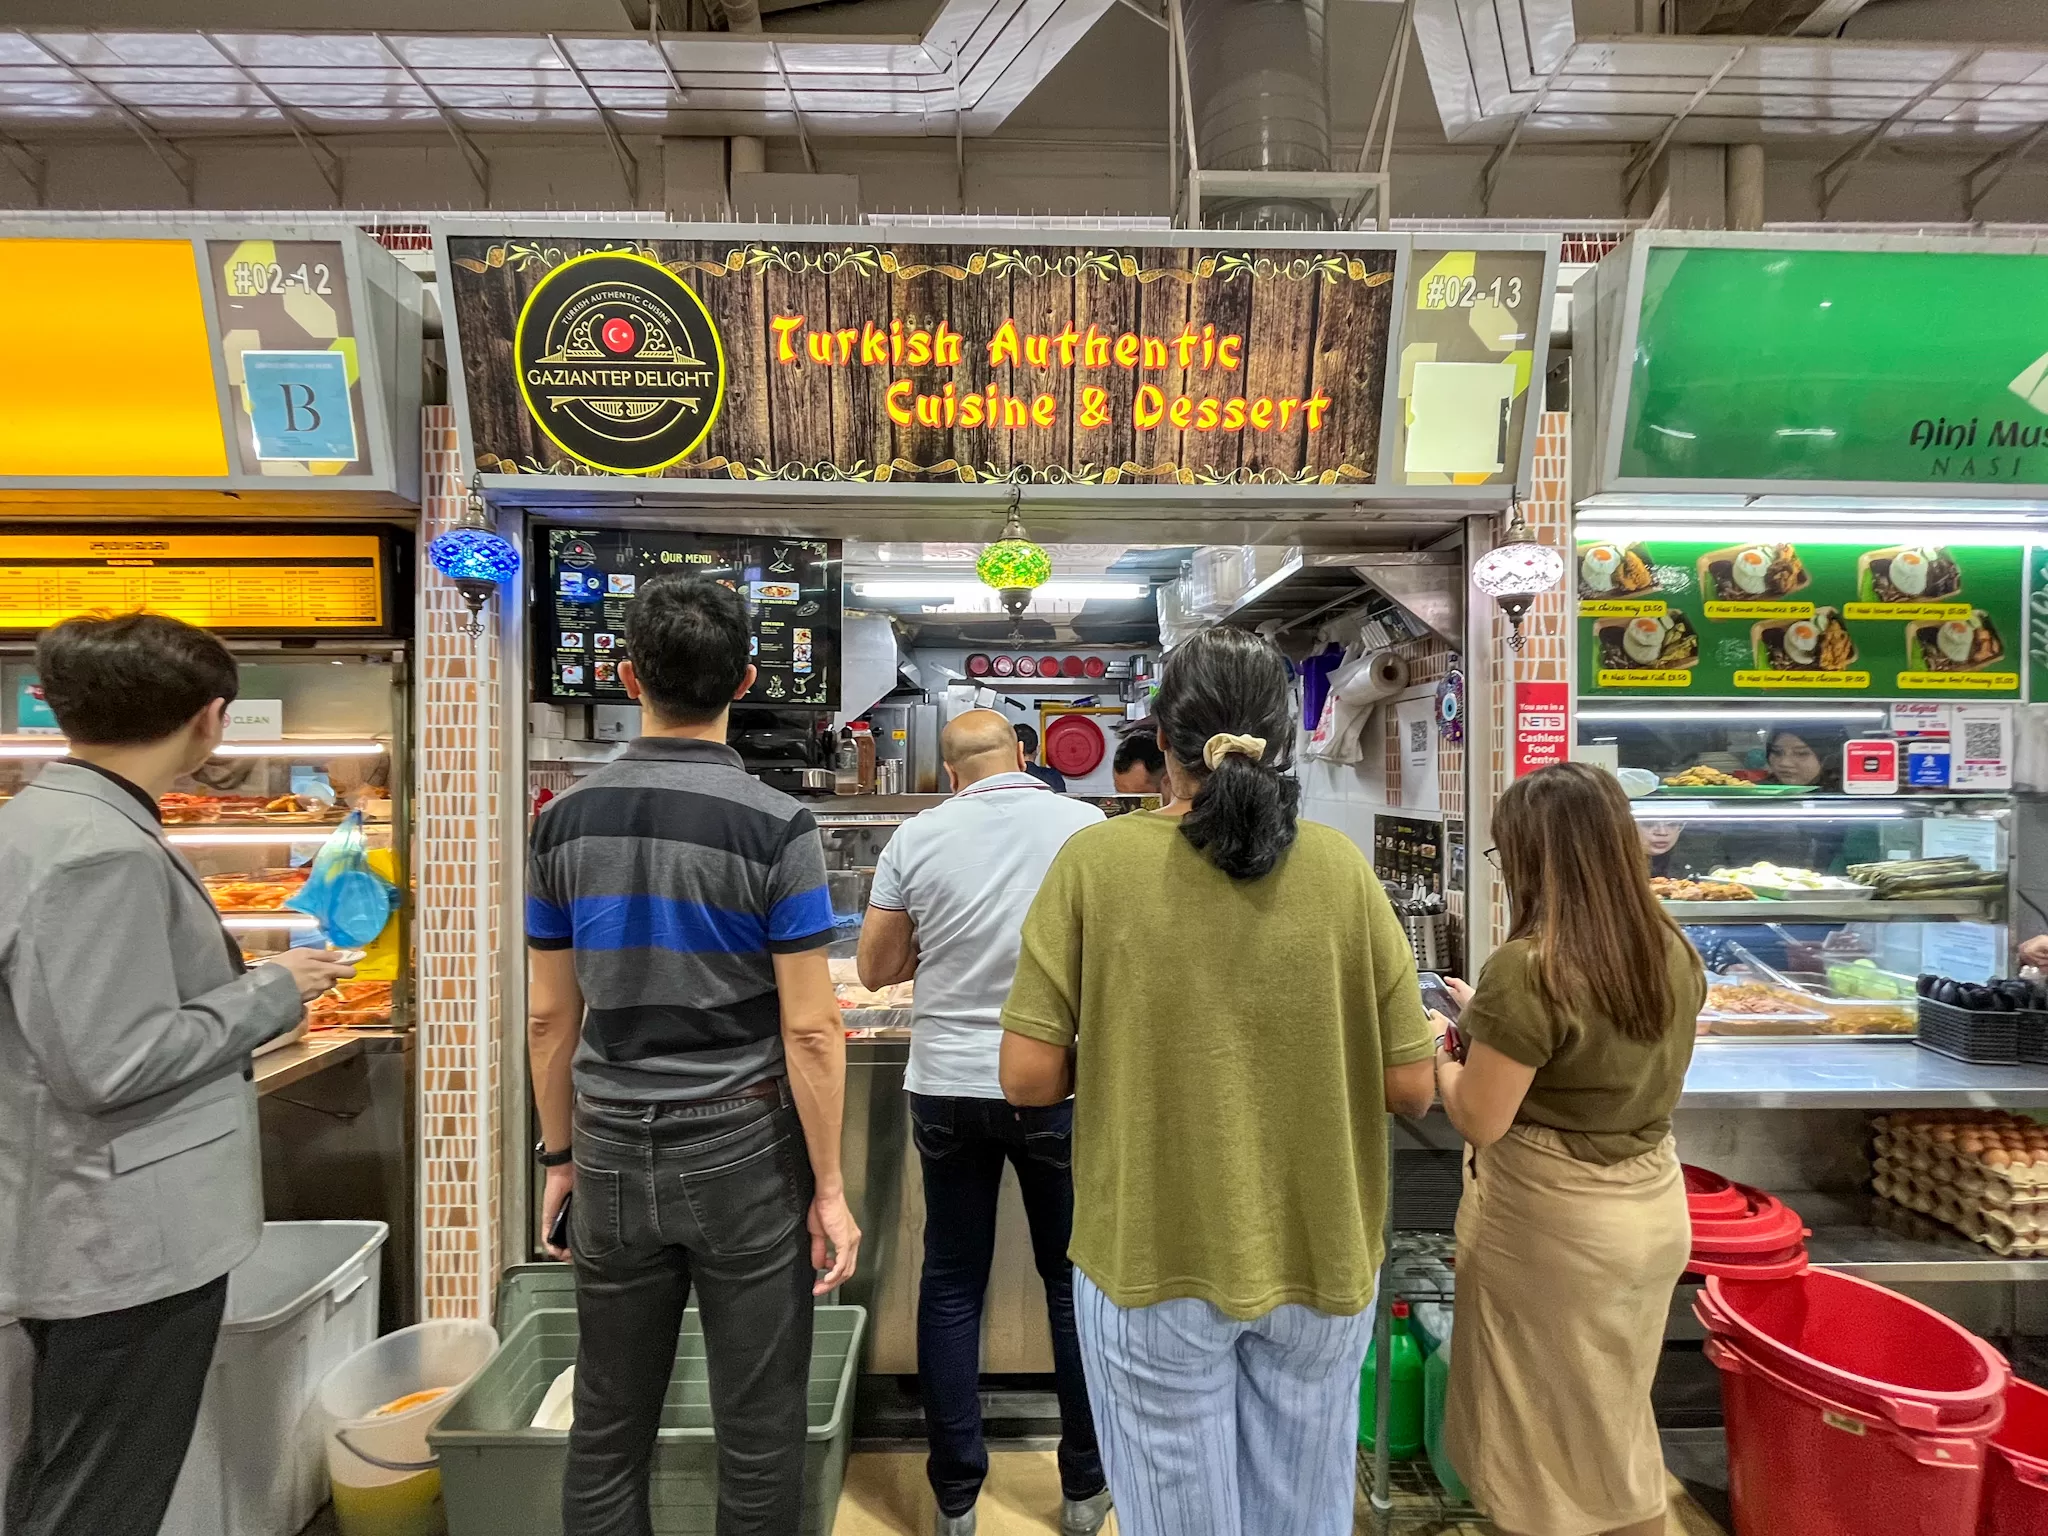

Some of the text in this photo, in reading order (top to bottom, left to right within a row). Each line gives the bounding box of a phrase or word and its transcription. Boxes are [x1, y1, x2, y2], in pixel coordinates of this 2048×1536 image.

[233, 262, 332, 295] #02-12
[1427, 275, 1523, 309] #02-13
[561, 291, 673, 327] TURKISH AUTHENTIC CUISINE
[770, 314, 1243, 370] Turkish Authentic
[527, 369, 715, 388] GAZIANTEP DELIGHT
[278, 383, 322, 432] B
[885, 378, 1331, 431] Cuisine & Dessert
[1909, 417, 1978, 450] Aini
[1930, 456, 2021, 476] NASI
[1519, 703, 1534, 711] You
[1549, 703, 1558, 711] in
[233, 716, 270, 725] CLEAN
[1522, 716, 1561, 727] NETS
[1518, 732, 1566, 743] Cashless
[1527, 743, 1556, 754] Food
[1523, 754, 1561, 765] Centre
